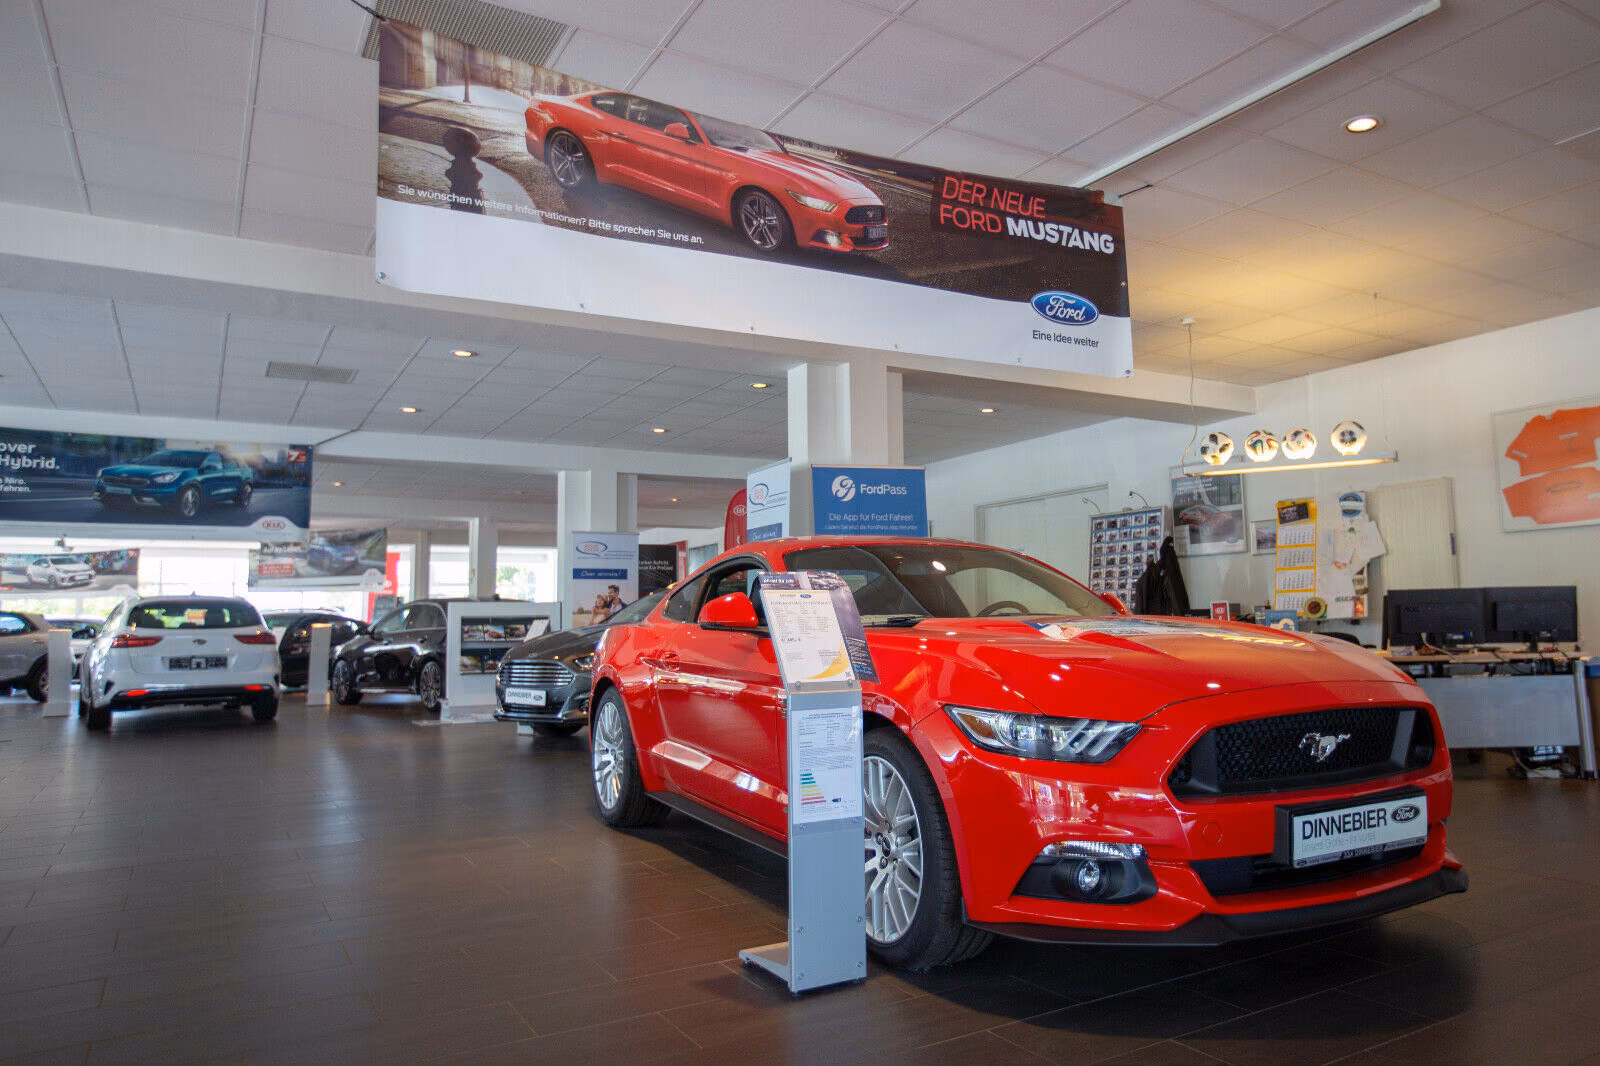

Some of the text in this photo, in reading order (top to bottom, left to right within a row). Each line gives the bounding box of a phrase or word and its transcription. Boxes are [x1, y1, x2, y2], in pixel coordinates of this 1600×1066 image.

[942, 176, 1046, 219] DER NEUE
[398, 184, 705, 244] Sie wünschen weitere Informationen? Bitte sprechen Sie uns an.
[939, 203, 1115, 254] FORD MUSTANG
[1045, 295, 1087, 321] Ford
[1032, 329, 1099, 348] Eine Idee weiter
[860, 483, 907, 495] FordPass
[828, 513, 842, 521] Die
[843, 513, 859, 522] App
[859, 513, 870, 522] für
[871, 513, 888, 521] Ford
[1301, 807, 1387, 841] DINNEBIER
